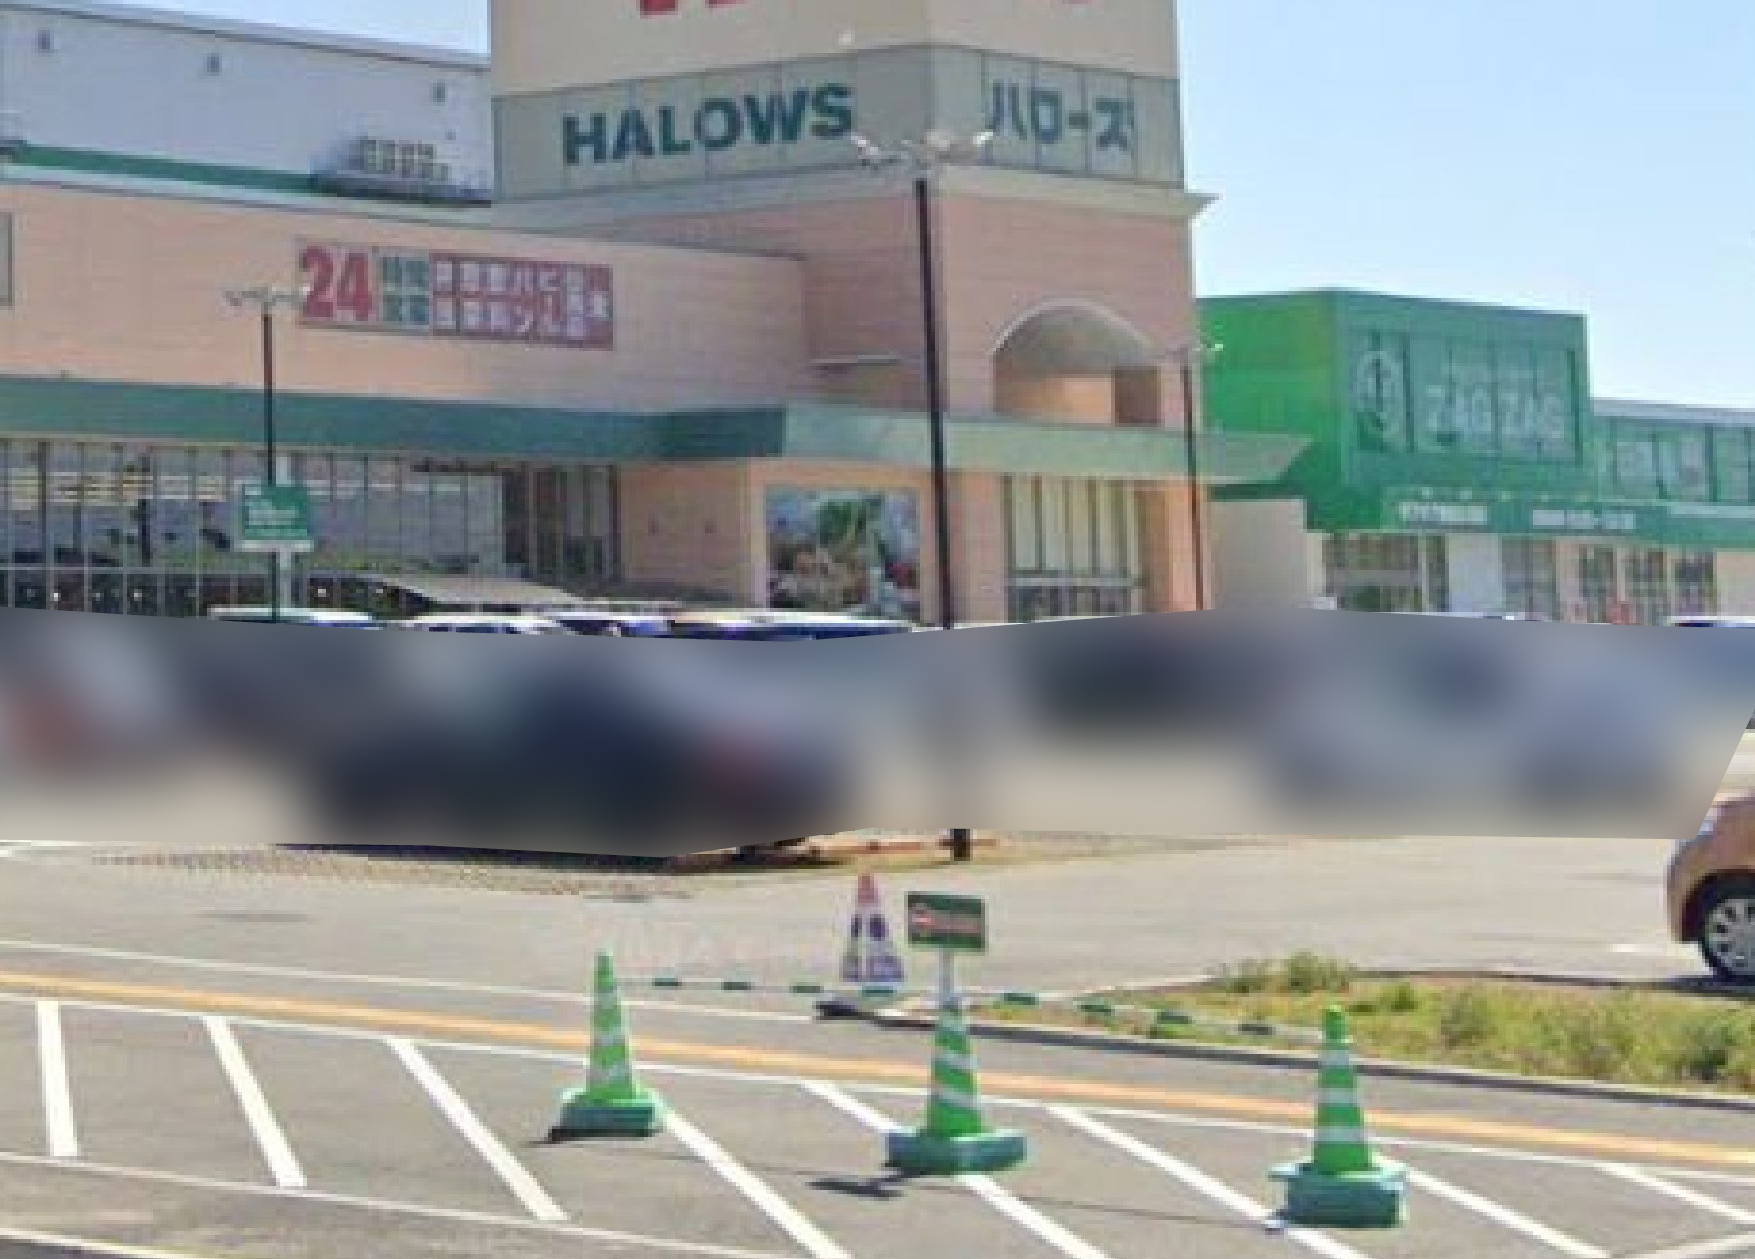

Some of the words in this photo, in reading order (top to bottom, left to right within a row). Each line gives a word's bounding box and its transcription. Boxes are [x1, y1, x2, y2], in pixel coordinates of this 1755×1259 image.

[562, 82, 855, 165] HALOWS
[984, 76, 1137, 151] ハローズ
[301, 245, 370, 322] 24
